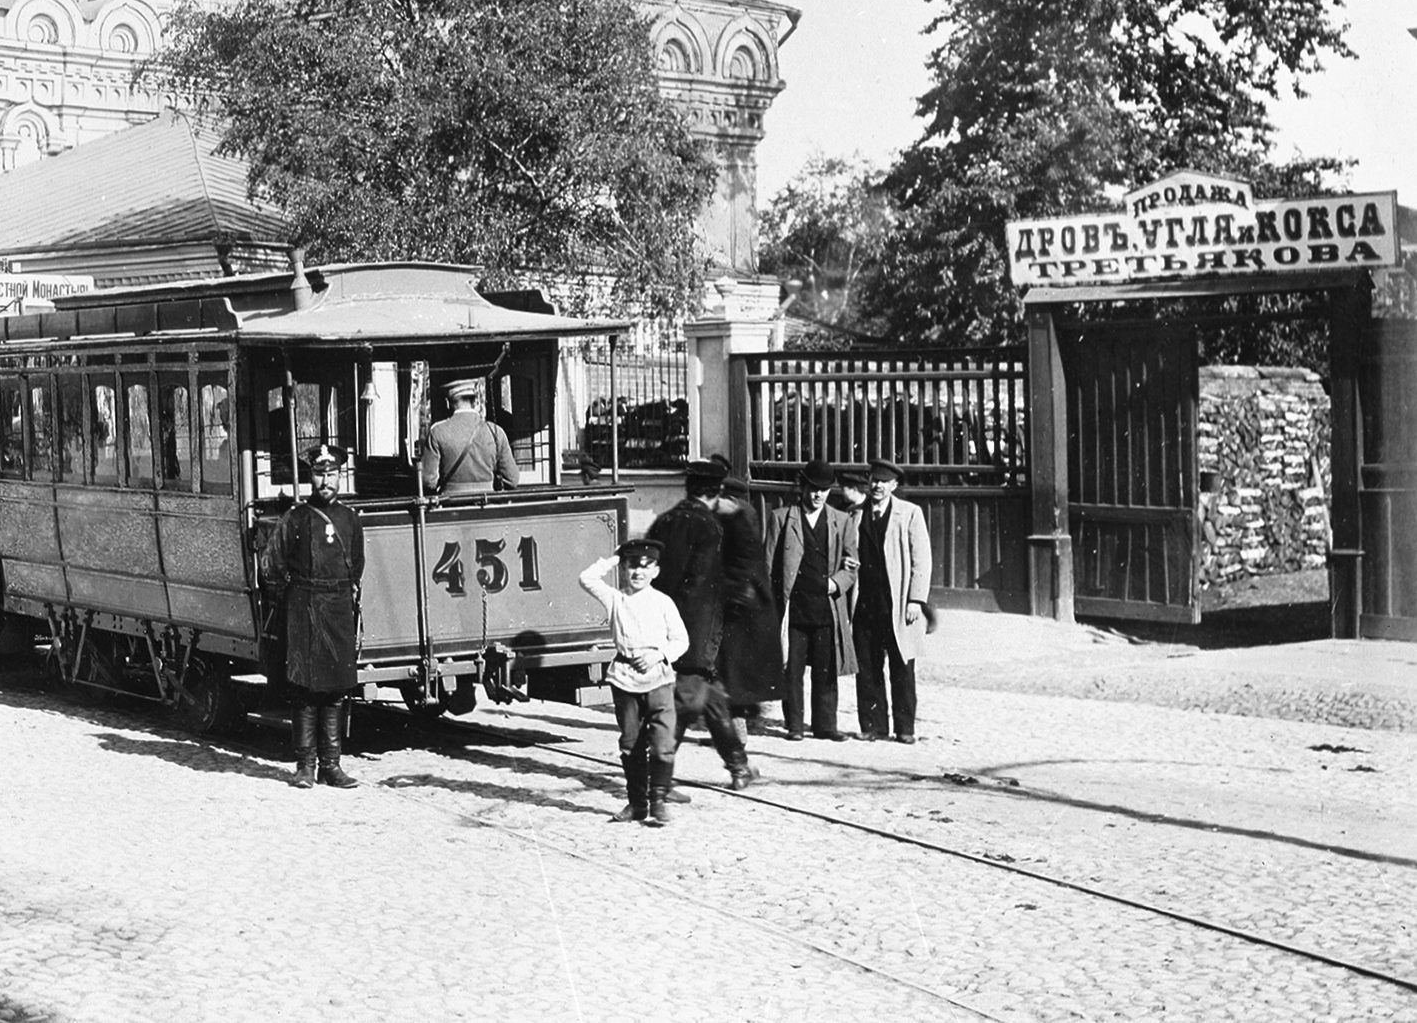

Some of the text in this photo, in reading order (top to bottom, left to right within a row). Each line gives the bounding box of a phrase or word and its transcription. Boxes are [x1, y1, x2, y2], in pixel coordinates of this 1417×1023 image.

[1133, 183, 1249, 219] ПРОДАЖА
[1138, 213, 1237, 249] УГЛЯ
[1255, 202, 1386, 243] КОКСА
[1028, 240, 1382, 279] ТРЕТЬЯКОВА
[432, 535, 542, 598] 451
